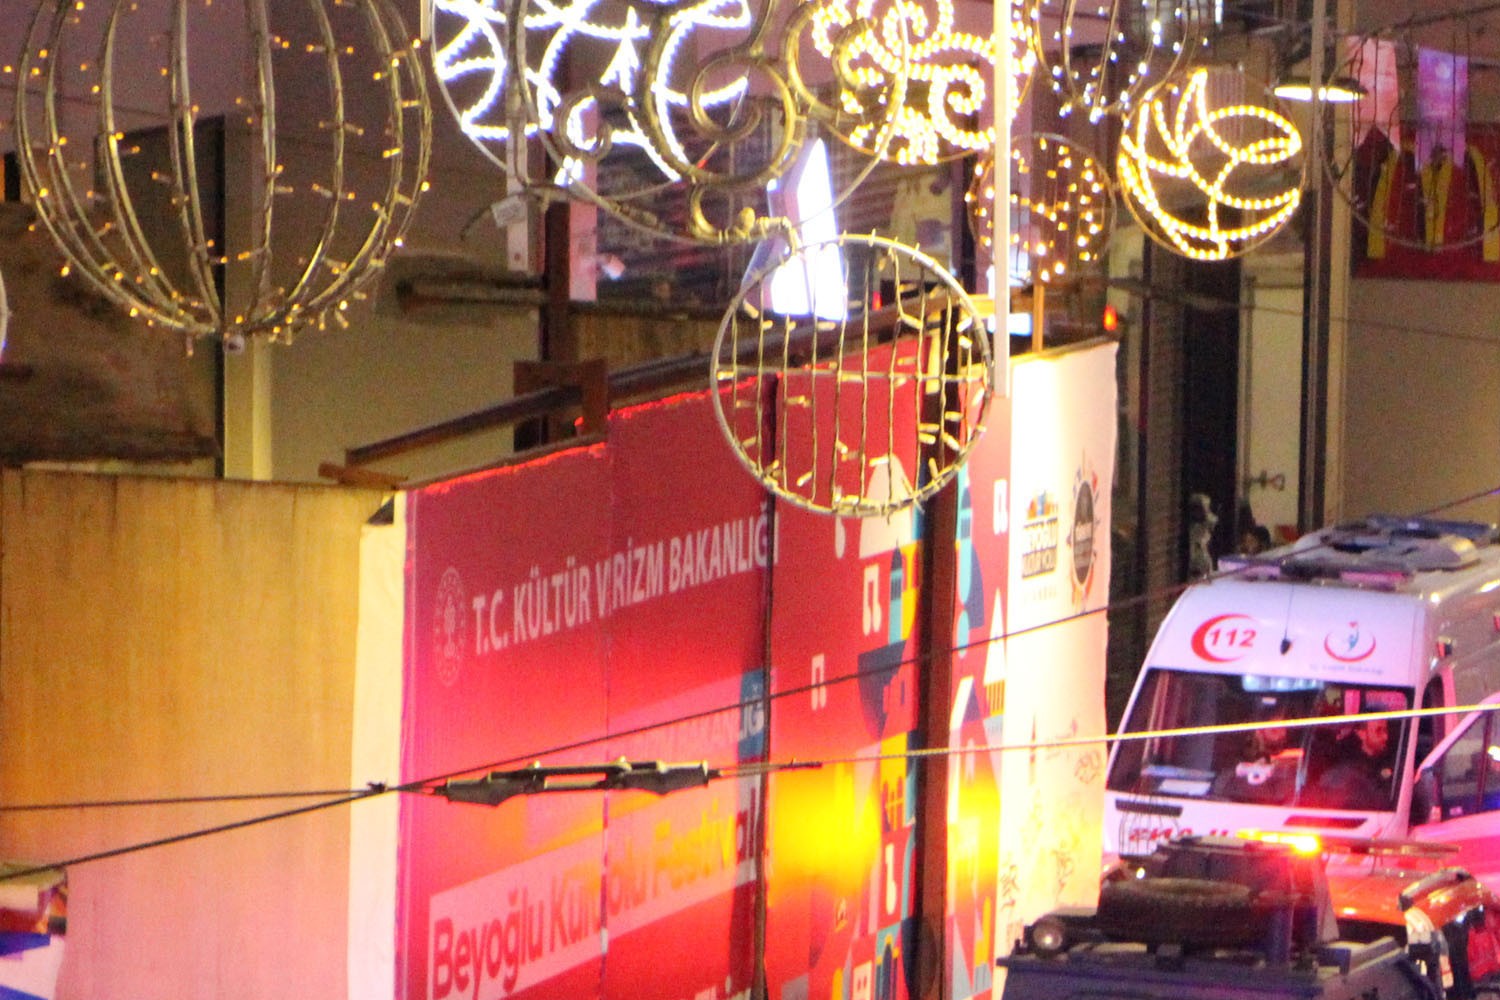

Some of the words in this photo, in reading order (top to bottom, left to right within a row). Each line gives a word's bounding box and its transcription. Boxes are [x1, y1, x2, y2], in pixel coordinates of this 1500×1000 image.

[472, 589, 509, 656] T.C.
[512, 556, 591, 644] KÜLTÜR
[669, 502, 780, 593] BAKANLIĞI
[1208, 627, 1257, 649] 112
